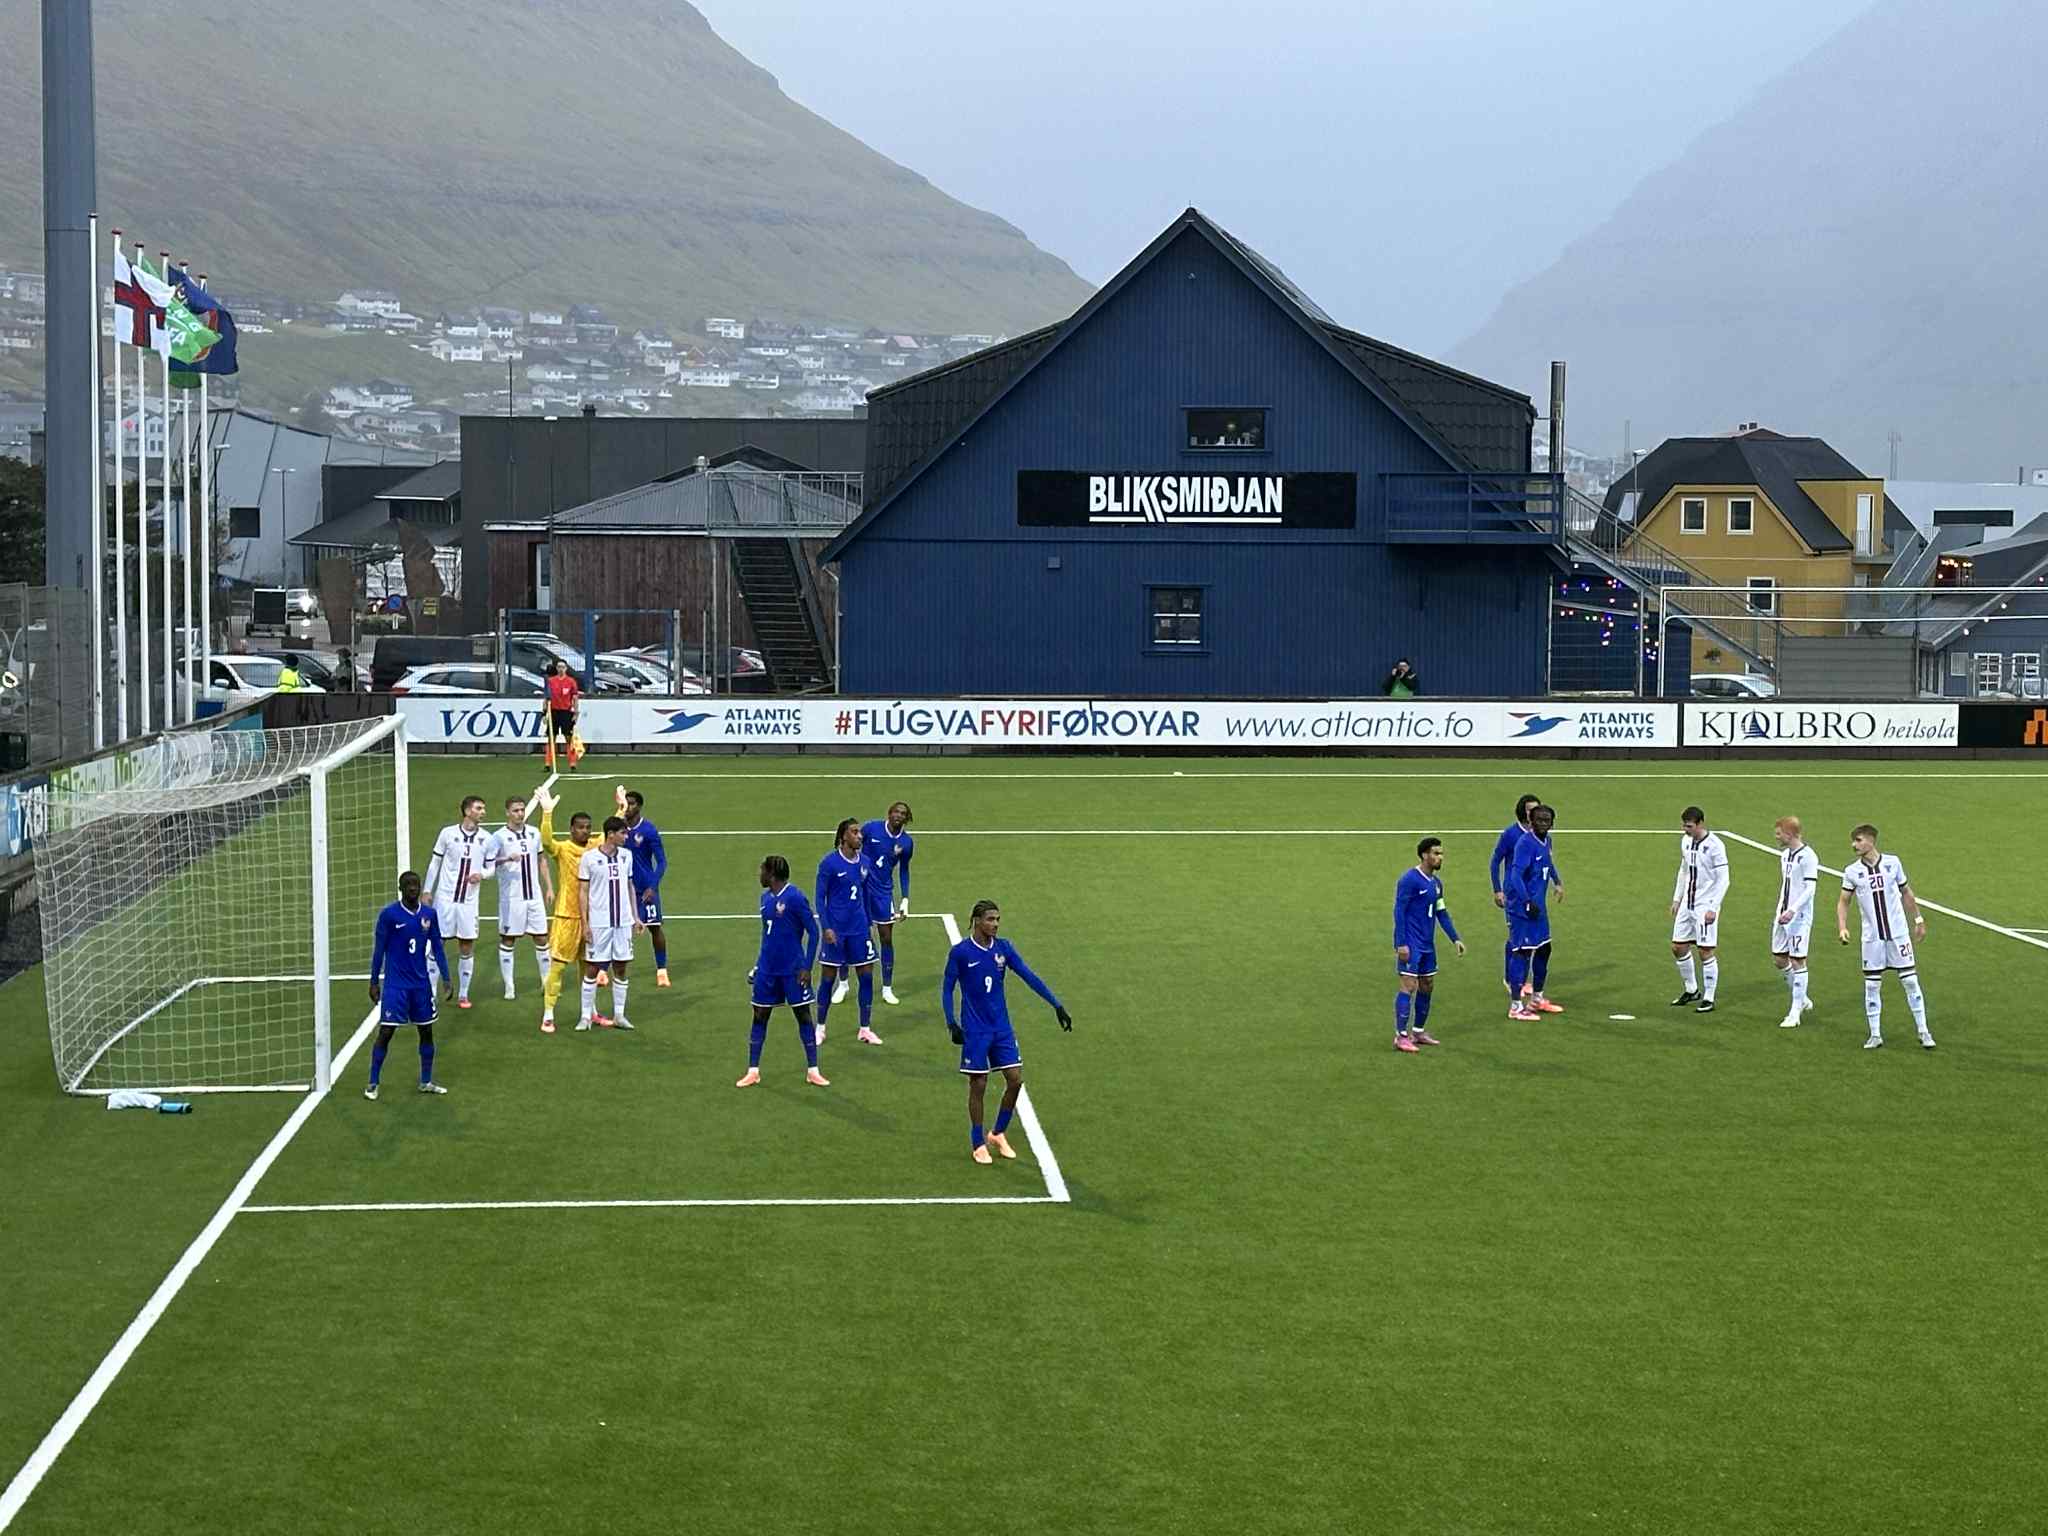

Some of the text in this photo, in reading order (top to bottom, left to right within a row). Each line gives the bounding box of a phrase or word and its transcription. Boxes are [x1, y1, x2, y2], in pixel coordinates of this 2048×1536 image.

[439, 702, 550, 738] VÓNI
[724, 708, 802, 721] ATLANTIC
[835, 701, 1200, 738] #FLÚGVAFYRIFØROYAR
[1579, 712, 1655, 725] ATLANTIC
[724, 722, 802, 735] AIRWAYS
[1225, 710, 1474, 738] www.atlantic.fo
[1883, 717, 1956, 739] heilsøla
[1578, 726, 1655, 739] AIRWAYS
[608, 864, 619, 878] 15
[1868, 875, 1884, 890] 20
[849, 884, 858, 900] 2
[646, 904, 657, 918] 13
[408, 938, 417, 954] 3
[984, 975, 993, 993] 9
